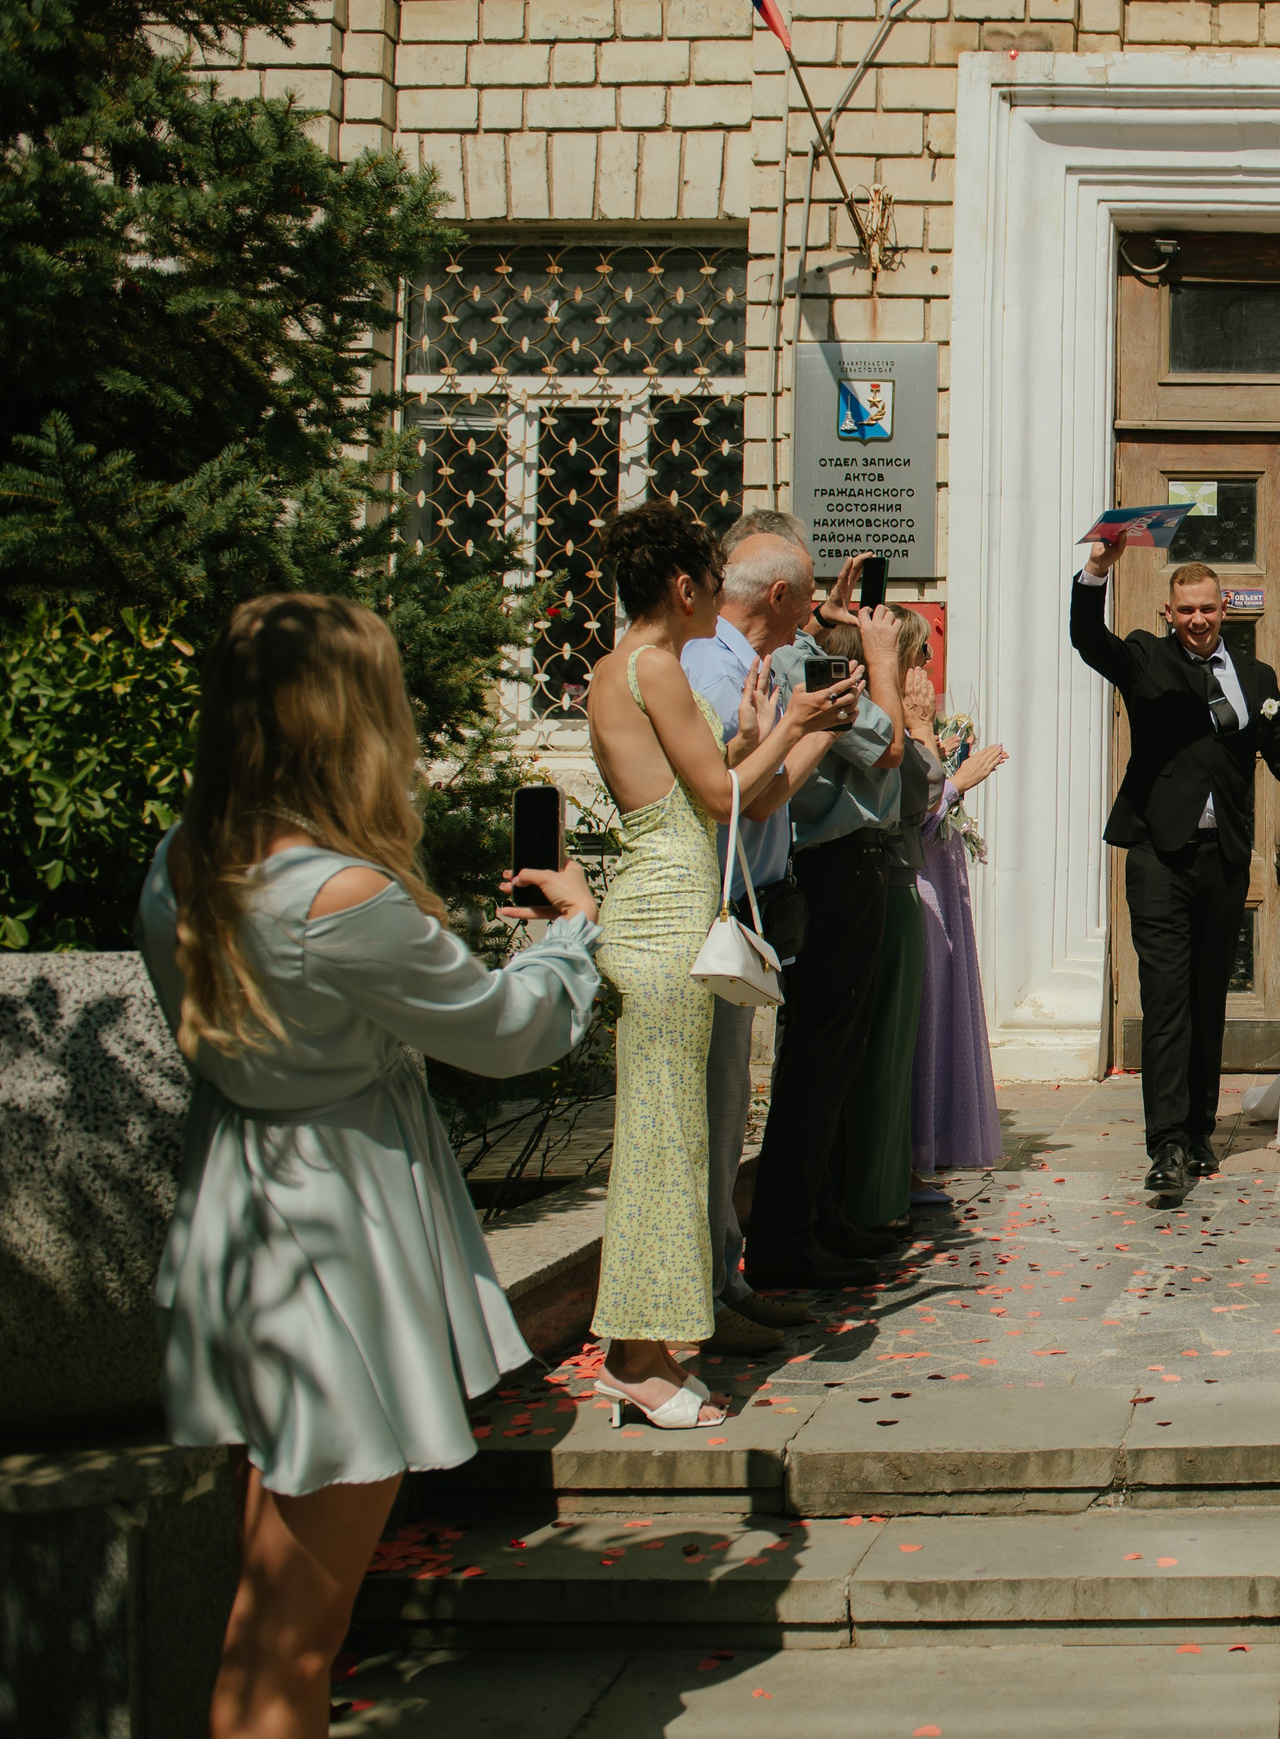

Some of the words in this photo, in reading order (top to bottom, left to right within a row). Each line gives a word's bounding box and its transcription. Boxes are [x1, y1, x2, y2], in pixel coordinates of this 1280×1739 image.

[819, 458, 858, 467] ОТДЕЛ
[862, 458, 910, 467] ЗАПИСИ
[845, 473, 884, 481] АКТОВ
[814, 489, 914, 498] ГРАЖДАНСКОГО
[827, 504, 902, 512] СОСТОЯНИЯ
[814, 519, 914, 527] НАХИМОВСКОГО
[813, 533, 861, 542] РАЙОНА
[866, 534, 915, 543] ГОРОДА
